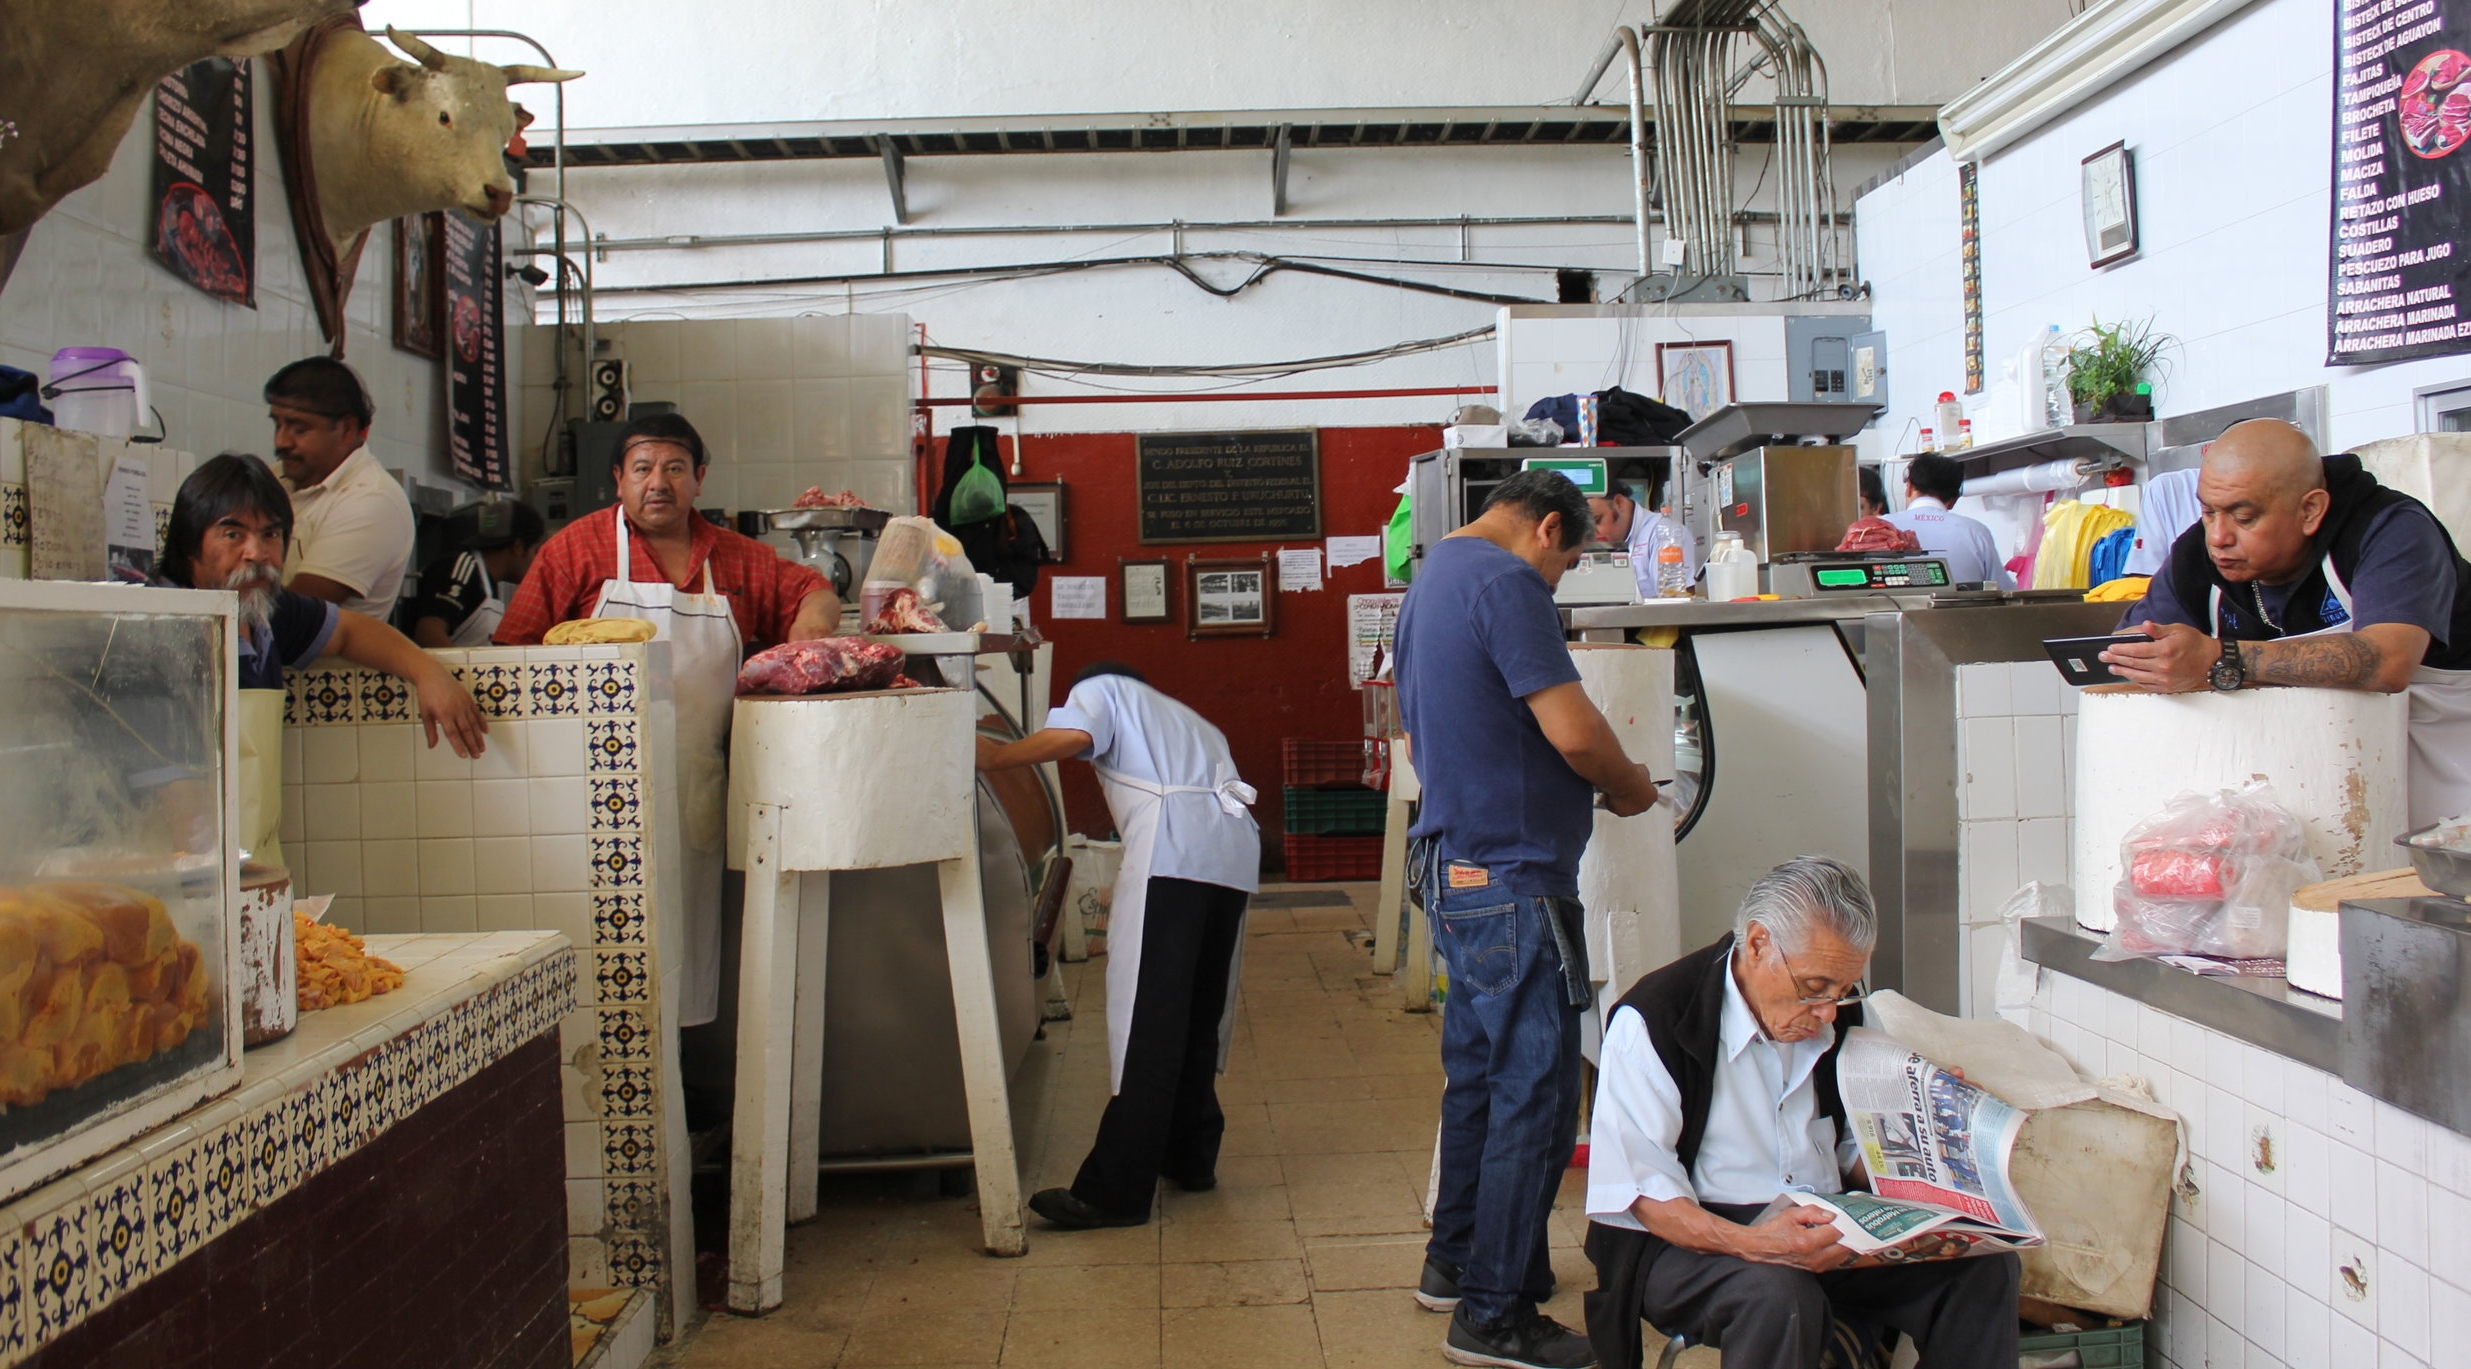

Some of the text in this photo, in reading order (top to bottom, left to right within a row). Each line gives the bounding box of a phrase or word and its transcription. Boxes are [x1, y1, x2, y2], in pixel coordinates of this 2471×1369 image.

[2343, 4, 2380, 31] BISTECK
[2380, 0, 2394, 14] DE
[2343, 0, 2434, 50] BISTECK DE CENTRO
[2343, 16, 2441, 69] BISTECK DE AGUAYON
[2342, 63, 2384, 87] FAJITAS
[2342, 74, 2403, 106] TAMPIQUEÑA
[2342, 98, 2396, 125] BROCHETA
[2341, 122, 2381, 144] FILETE
[2340, 141, 2384, 163] MOLIDA
[2340, 161, 2384, 182] MACIZA
[2339, 184, 2440, 220] RETAZO CON HUESO
[2340, 182, 2377, 202] FALDA
[2338, 216, 2399, 239] COSTILLAS
[2338, 237, 2392, 258] SUADERO
[2338, 242, 2451, 277] PESCUEZO PARA JUGO
[2337, 274, 2401, 296] SABANITAS
[2336, 284, 2452, 315] ARRACHERA NATURAL
[2334, 303, 2456, 334] ARRACHERA MARINADA
[2334, 332, 2404, 353] ARRACHERA
[2405, 324, 2456, 346] MARINADA
[1239, 445, 1252, 454] LA
[1166, 458, 1214, 470] ADOLFO
[1217, 456, 1243, 468] RUIZ
[1248, 455, 1303, 467] CORTINES
[1180, 490, 1229, 503] ERNESTO
[1209, 518, 1251, 528] OCTUBRE
[1906, 1066, 1922, 1112] aferra
[1916, 1115, 1925, 1125] a
[1919, 1125, 1930, 1146] su
[1922, 1147, 1938, 1183] auto
